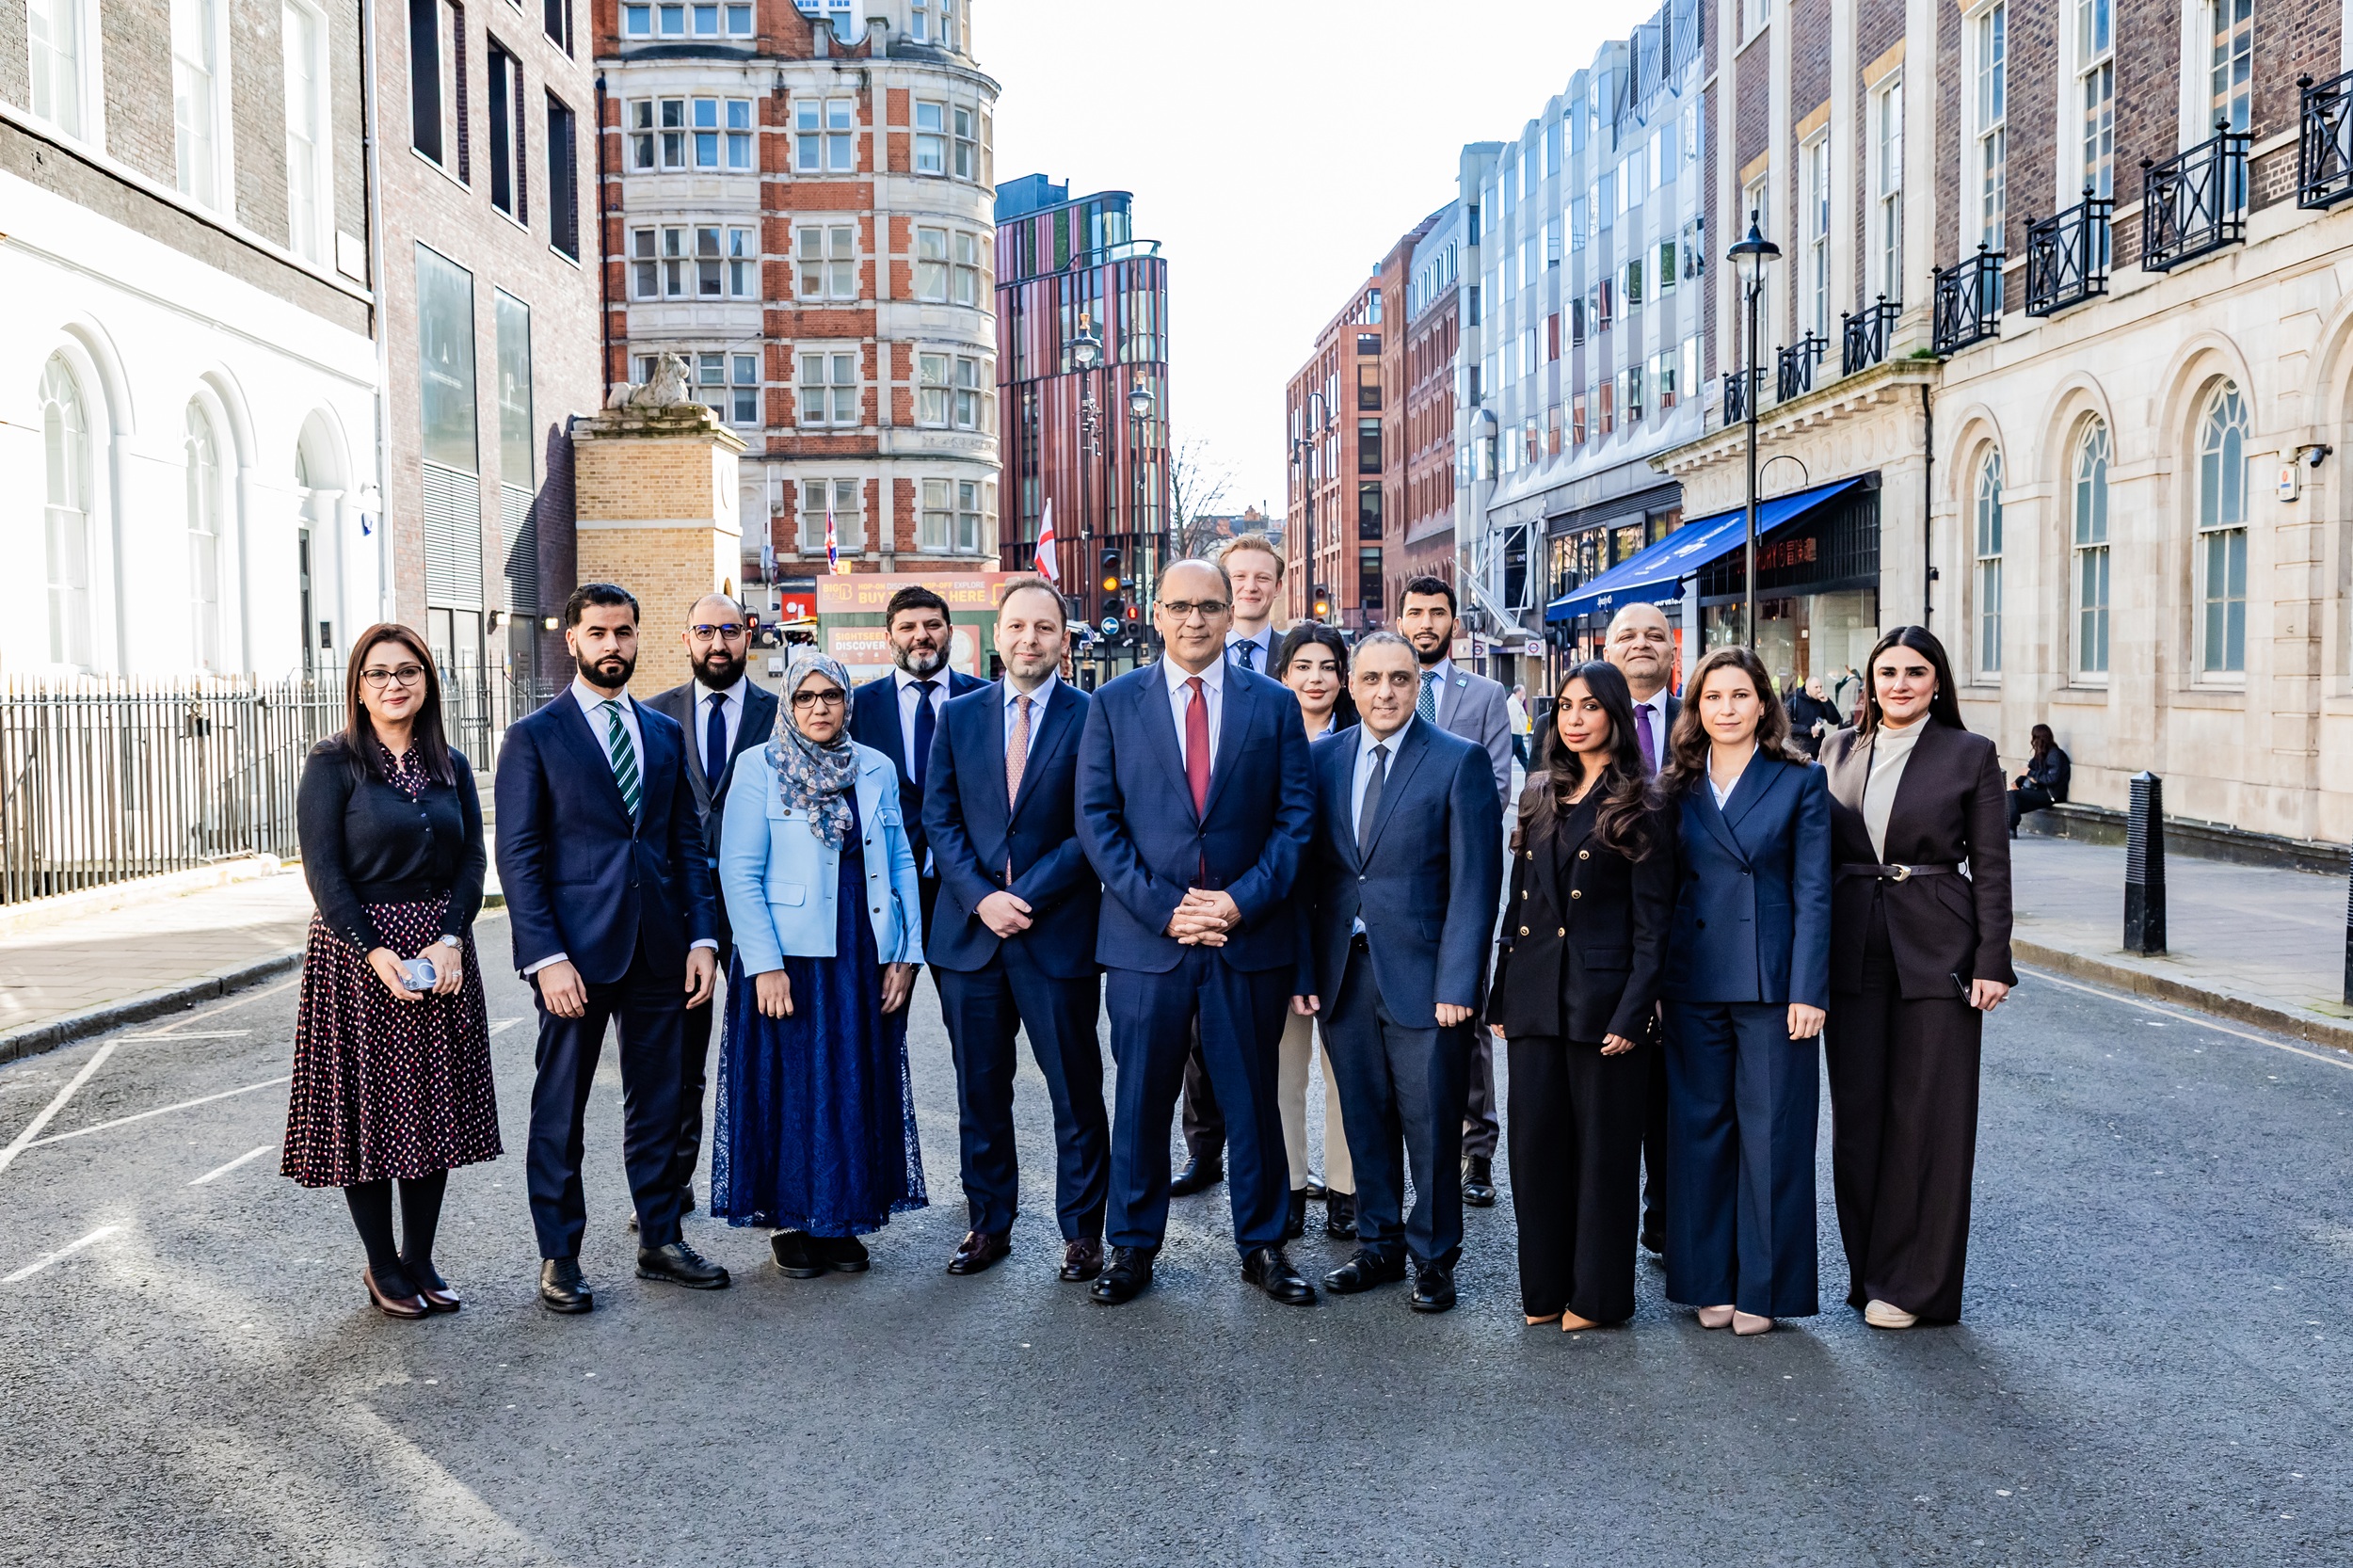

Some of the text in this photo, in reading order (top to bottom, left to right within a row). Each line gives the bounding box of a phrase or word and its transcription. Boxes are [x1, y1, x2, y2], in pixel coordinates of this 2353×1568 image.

[823, 584, 839, 592] BIG
[823, 592, 839, 600] BUS
[858, 592, 885, 603] BUY
[950, 590, 985, 602] HERE
[835, 632, 884, 641] SIGHTSEEI
[835, 641, 886, 650] DISCOVER
